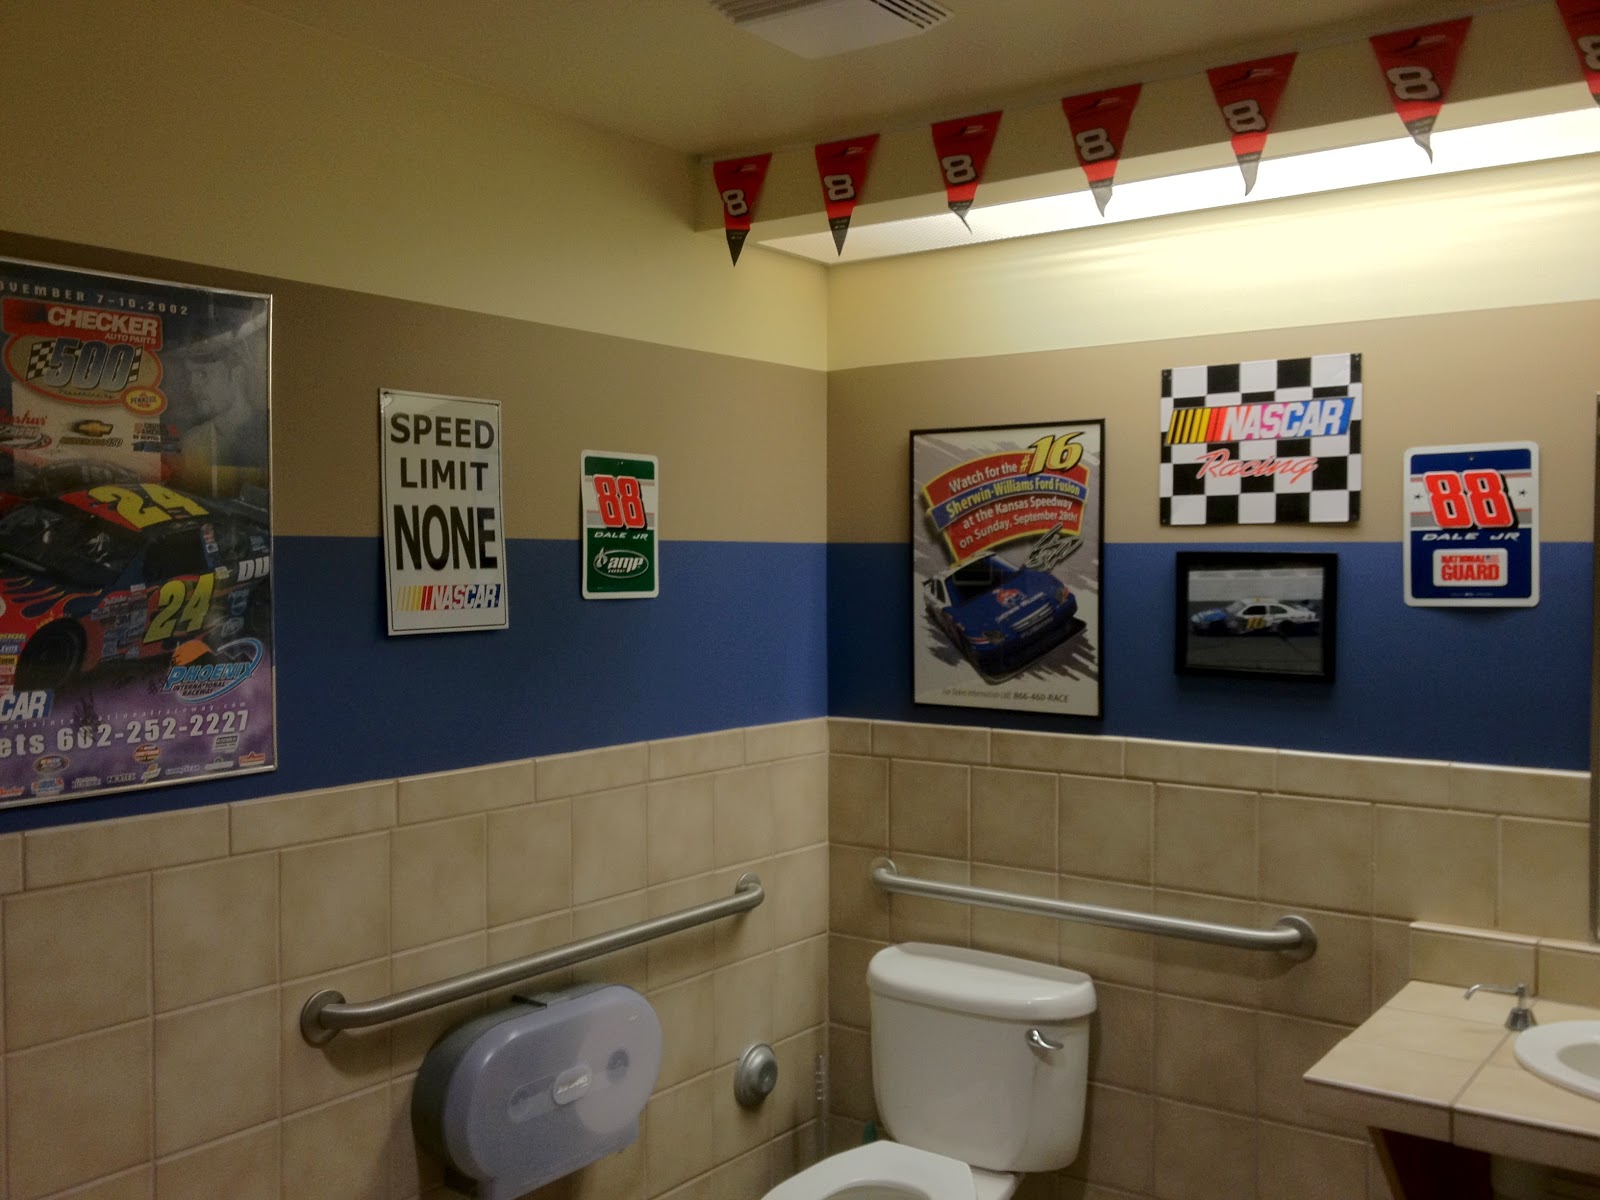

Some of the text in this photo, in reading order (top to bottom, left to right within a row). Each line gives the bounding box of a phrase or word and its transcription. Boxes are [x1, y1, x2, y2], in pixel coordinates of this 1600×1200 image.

[1385, 66, 1441, 102] 8
[1222, 99, 1267, 134] 8
[1075, 127, 1116, 162] 8
[941, 154, 978, 184] 8
[722, 189, 748, 217] 8
[823, 174, 855, 201] 8
[47, 306, 158, 338] CHECKER
[105, 332, 157, 345] AUTO PARTS
[46, 337, 136, 392] 500
[390, 412, 495, 449] SPEED
[1220, 398, 1345, 441] NASCAR
[400, 458, 488, 490] LIMIT
[948, 470, 985, 493] Watch
[984, 465, 1001, 479] for
[1001, 462, 1018, 474] the
[1195, 448, 1319, 484] Racing
[87, 483, 210, 529] 24
[593, 474, 647, 529] 88
[945, 476, 1081, 518] Sherwin-Williams Ford Fusion
[962, 496, 1073, 529] at the Kansas Speedway
[1423, 468, 1517, 529] 88
[393, 504, 498, 571] NONE
[594, 531, 649, 541] DALE JR
[959, 536, 974, 549] on
[1013, 511, 1058, 525] September
[1422, 531, 1520, 542] DALE JR
[1441, 564, 1500, 581] GUARD
[143, 572, 215, 643] 24
[430, 583, 500, 610] NASCAR
[162, 661, 253, 692] PHOENIX
[172, 681, 226, 692] INTERNATIONAL
[182, 687, 214, 697] RACEWAY
